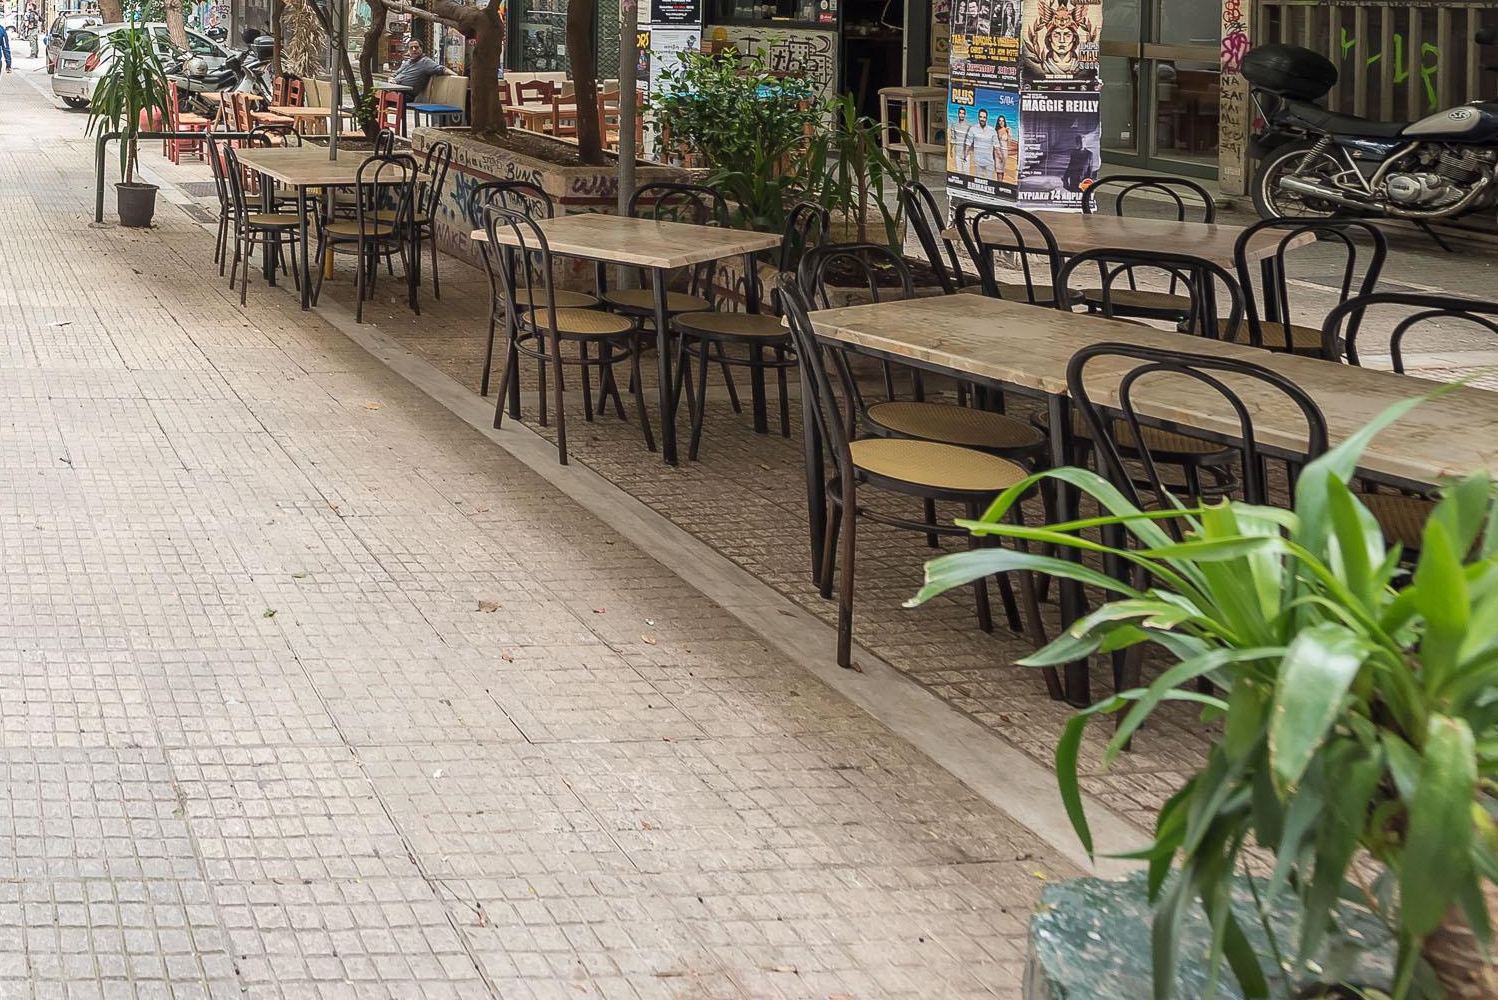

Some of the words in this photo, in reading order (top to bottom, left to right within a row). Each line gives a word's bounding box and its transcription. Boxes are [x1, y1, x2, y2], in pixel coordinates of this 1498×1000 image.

[1079, 51, 1099, 61] MAY
[952, 88, 974, 106] PLUS
[1022, 99, 1063, 112] MAGGIE
[1065, 100, 1099, 112] REILLY
[505, 161, 543, 187] BUNS
[1018, 191, 1049, 200] ΚΥΡΙΑΚΗ
[1050, 189, 1061, 200] 14
